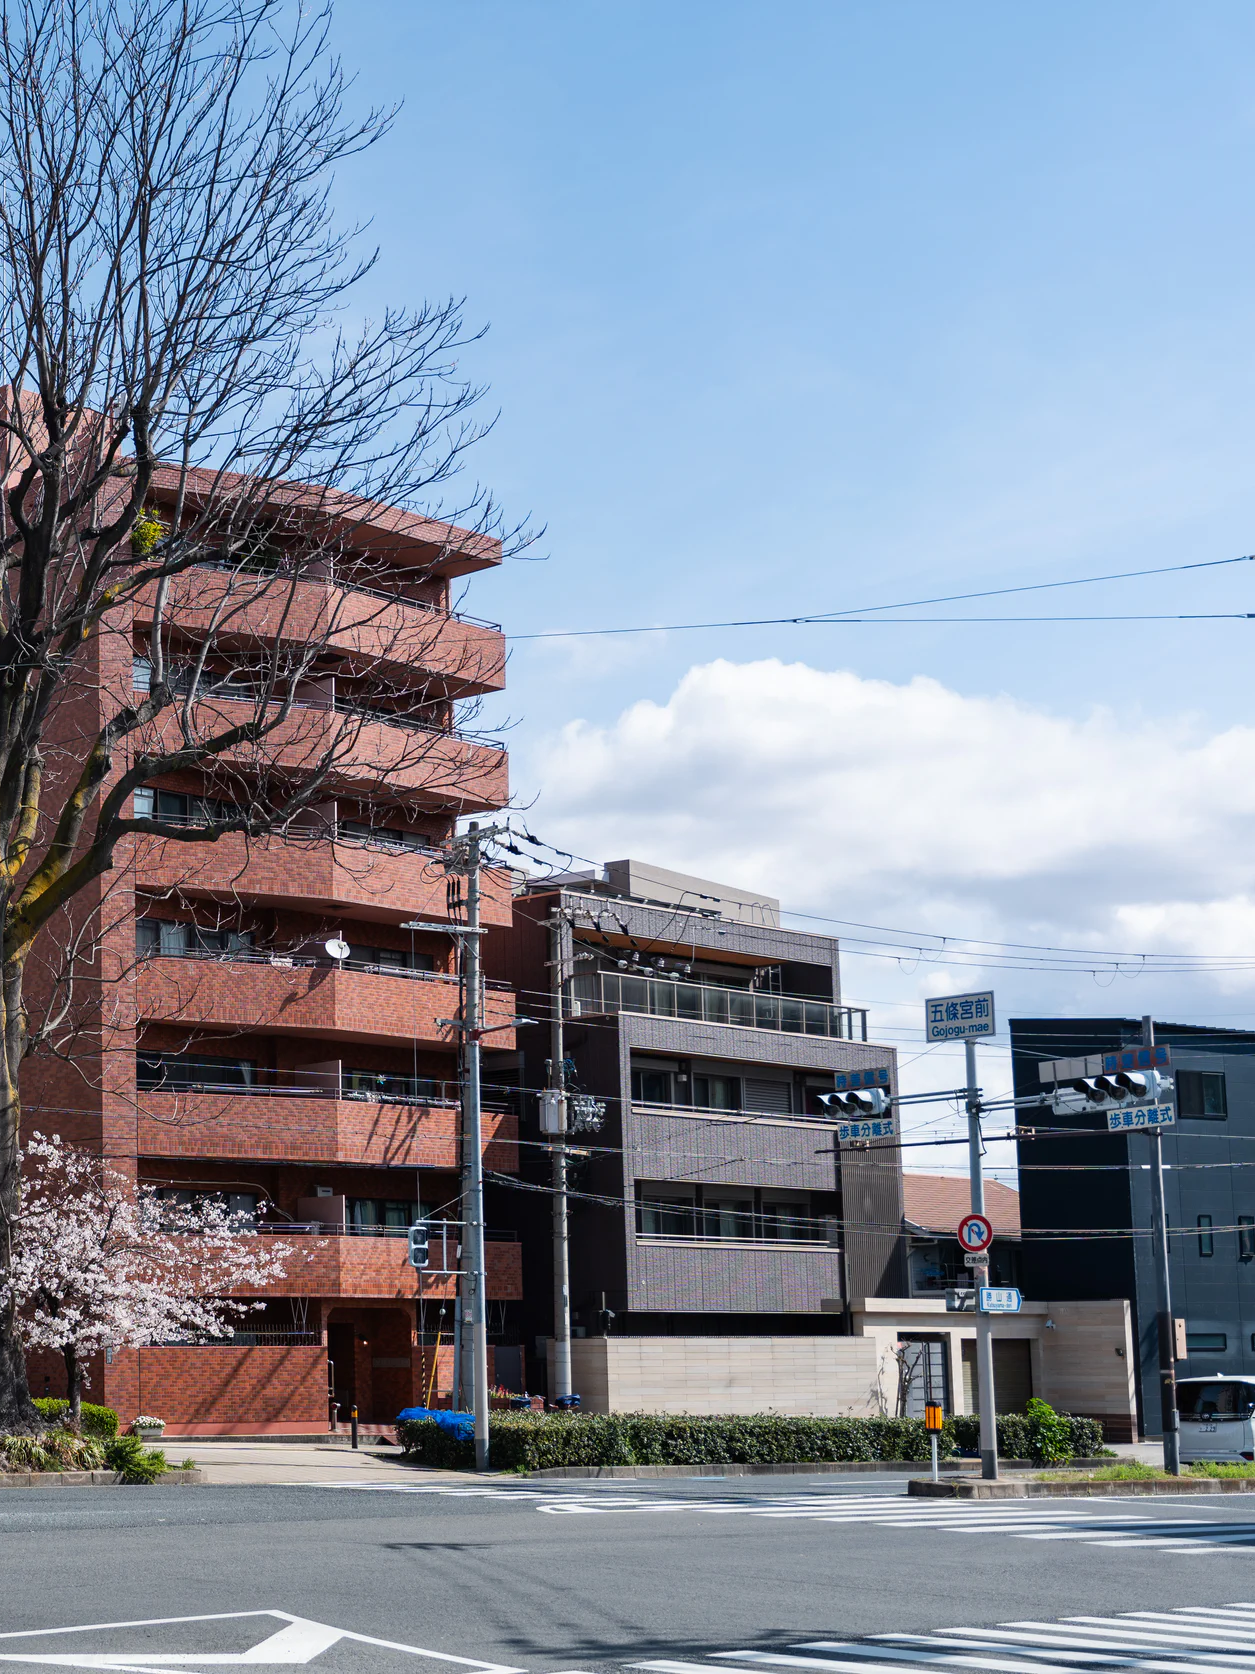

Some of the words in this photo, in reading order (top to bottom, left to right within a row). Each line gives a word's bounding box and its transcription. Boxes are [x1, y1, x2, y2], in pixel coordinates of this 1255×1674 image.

[930, 998, 989, 1023] 五條宮前
[931, 1023, 990, 1037] Gojogu-mae
[1109, 1106, 1173, 1129] 歩車分離式
[839, 1121, 894, 1140] 歩車分離式
